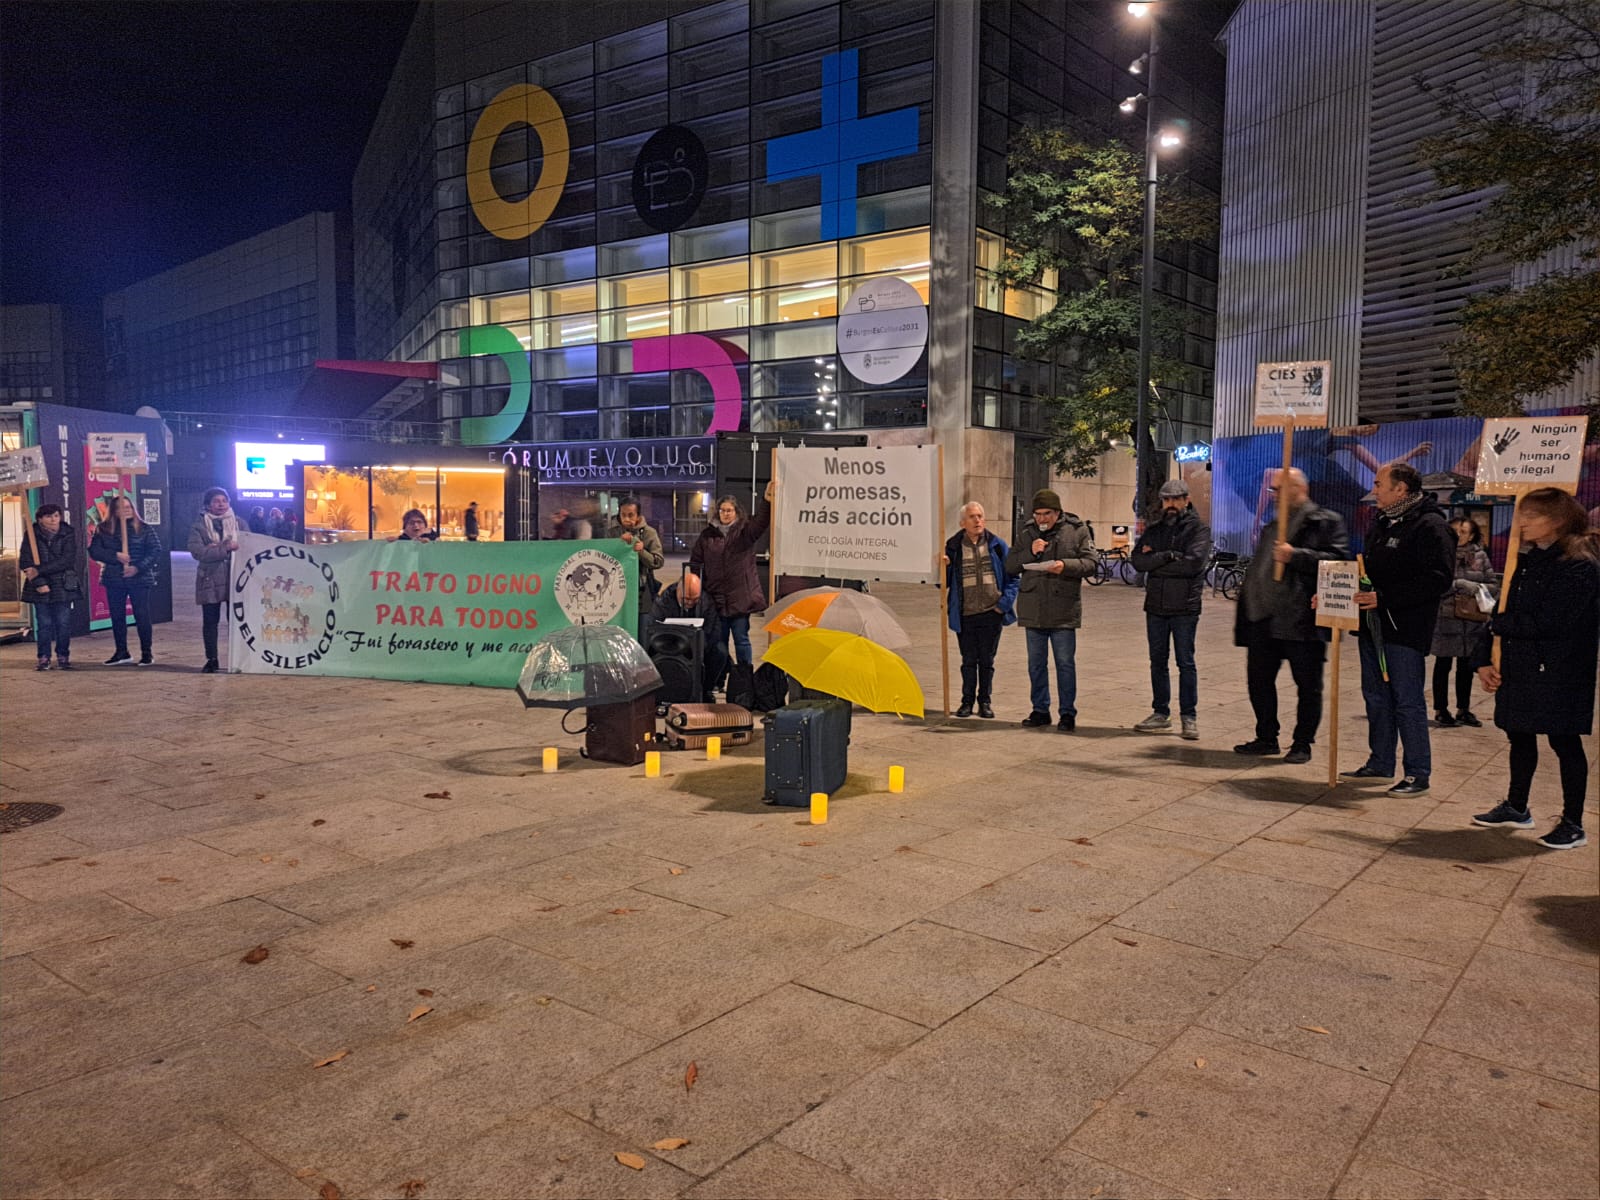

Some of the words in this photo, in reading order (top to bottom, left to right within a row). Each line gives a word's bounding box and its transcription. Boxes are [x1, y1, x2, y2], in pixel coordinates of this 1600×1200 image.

[1269, 368, 1297, 380] CIES
[1531, 424, 1577, 436] Ningún
[1540, 439, 1561, 447] ser
[1520, 452, 1571, 461] humano
[546, 469, 561, 478] DE
[568, 466, 653, 478] CONGRESOS
[663, 466, 670, 476] Y
[824, 457, 886, 475] Menos
[1503, 466, 1517, 474] es
[1521, 465, 1555, 476] ilegal
[806, 485, 907, 503] promesas,
[798, 506, 839, 525] más
[846, 507, 912, 526] acción
[808, 535, 853, 546] ECOLOGÍA
[855, 537, 899, 548] INTEGRAL
[817, 549, 823, 557] Y
[825, 550, 888, 561] MIGRACIONES
[235, 545, 340, 603] CIRCULOS
[555, 557, 575, 591] PASTORAL
[577, 550, 592, 559] CON
[369, 570, 457, 594] TRATO
[466, 573, 542, 595] DIGNO
[375, 604, 445, 628] PARA
[456, 607, 539, 630] TODOS
[233, 602, 256, 652] DEL
[261, 609, 336, 669] SILENCIO
[388, 632, 459, 655] forastero
[465, 643, 475, 658] y
[481, 642, 503, 654] me
[508, 642, 533, 654] aco
